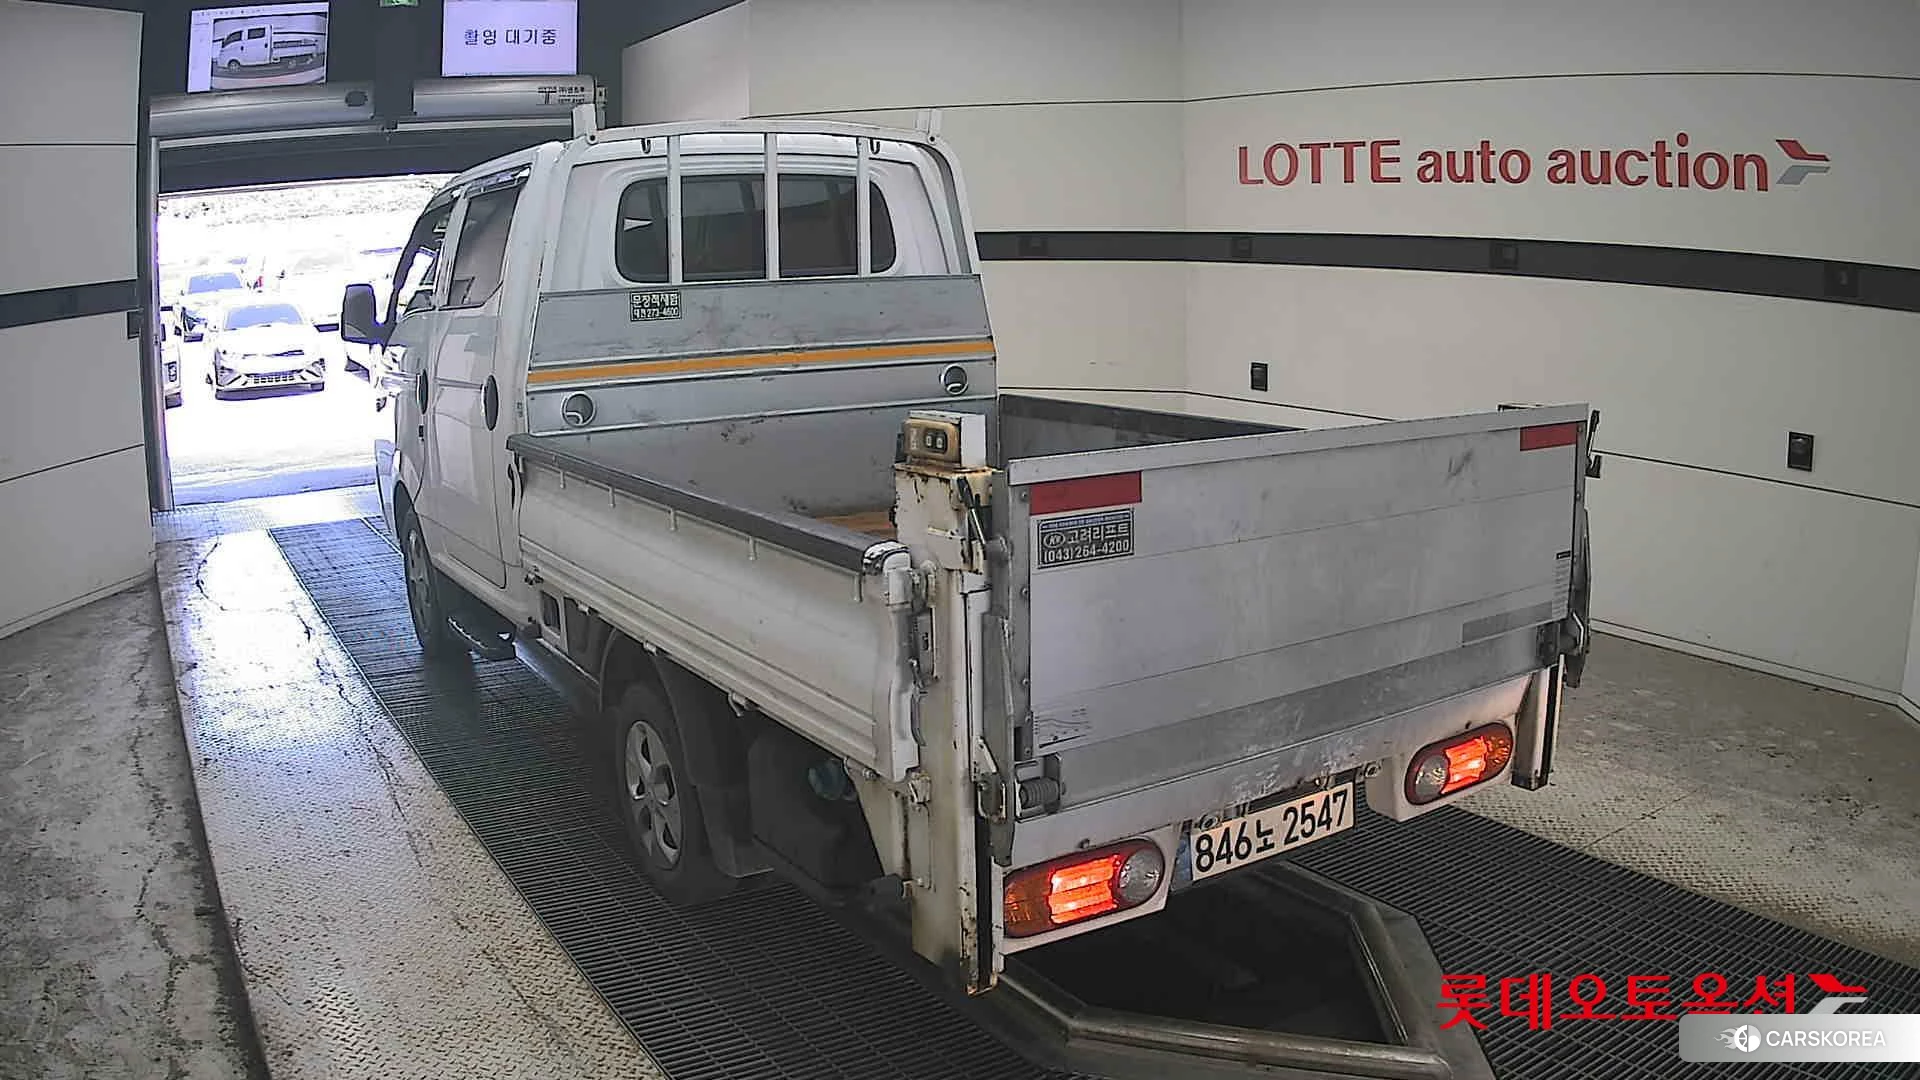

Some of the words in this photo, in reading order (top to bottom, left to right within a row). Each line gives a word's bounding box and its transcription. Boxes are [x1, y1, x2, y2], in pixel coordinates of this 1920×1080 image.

[505, 29, 557, 45] 대기중
[1238, 139, 1401, 186] LOTTE
[1416, 140, 1532, 185] auto
[1547, 132, 1770, 192] auction
[1067, 523, 1129, 544] 고려리프트
[1043, 539, 1129, 563] (043)264-4200
[1195, 818, 1275, 873] 846노
[1283, 789, 1348, 846] 2547
